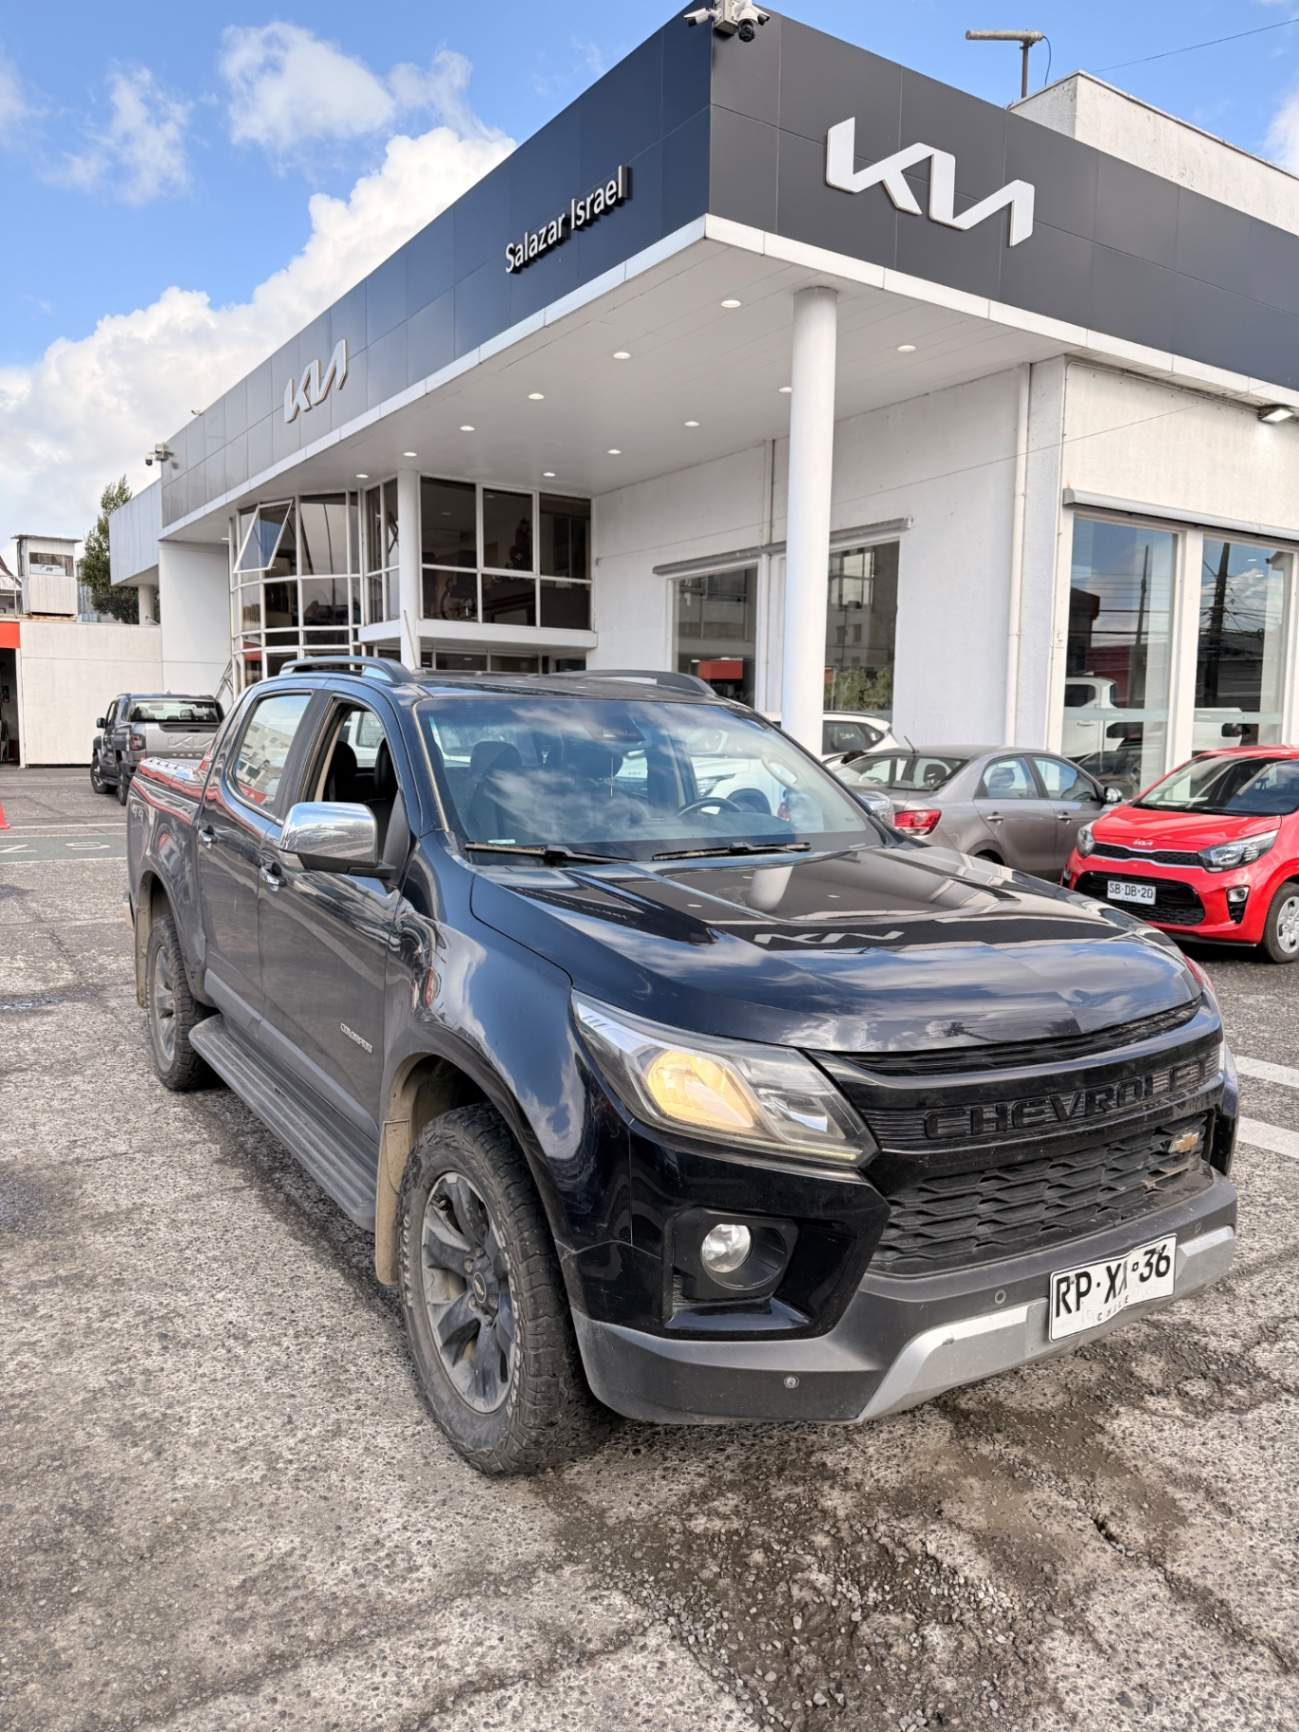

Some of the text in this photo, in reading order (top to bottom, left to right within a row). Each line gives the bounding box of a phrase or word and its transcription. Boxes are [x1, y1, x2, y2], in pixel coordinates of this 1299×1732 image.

[505, 165, 624, 273] Salazar Israel
[826, 117, 1035, 247] KIA
[284, 339, 348, 423] KIA
[923, 1054, 1211, 1139] CHEVROLET
